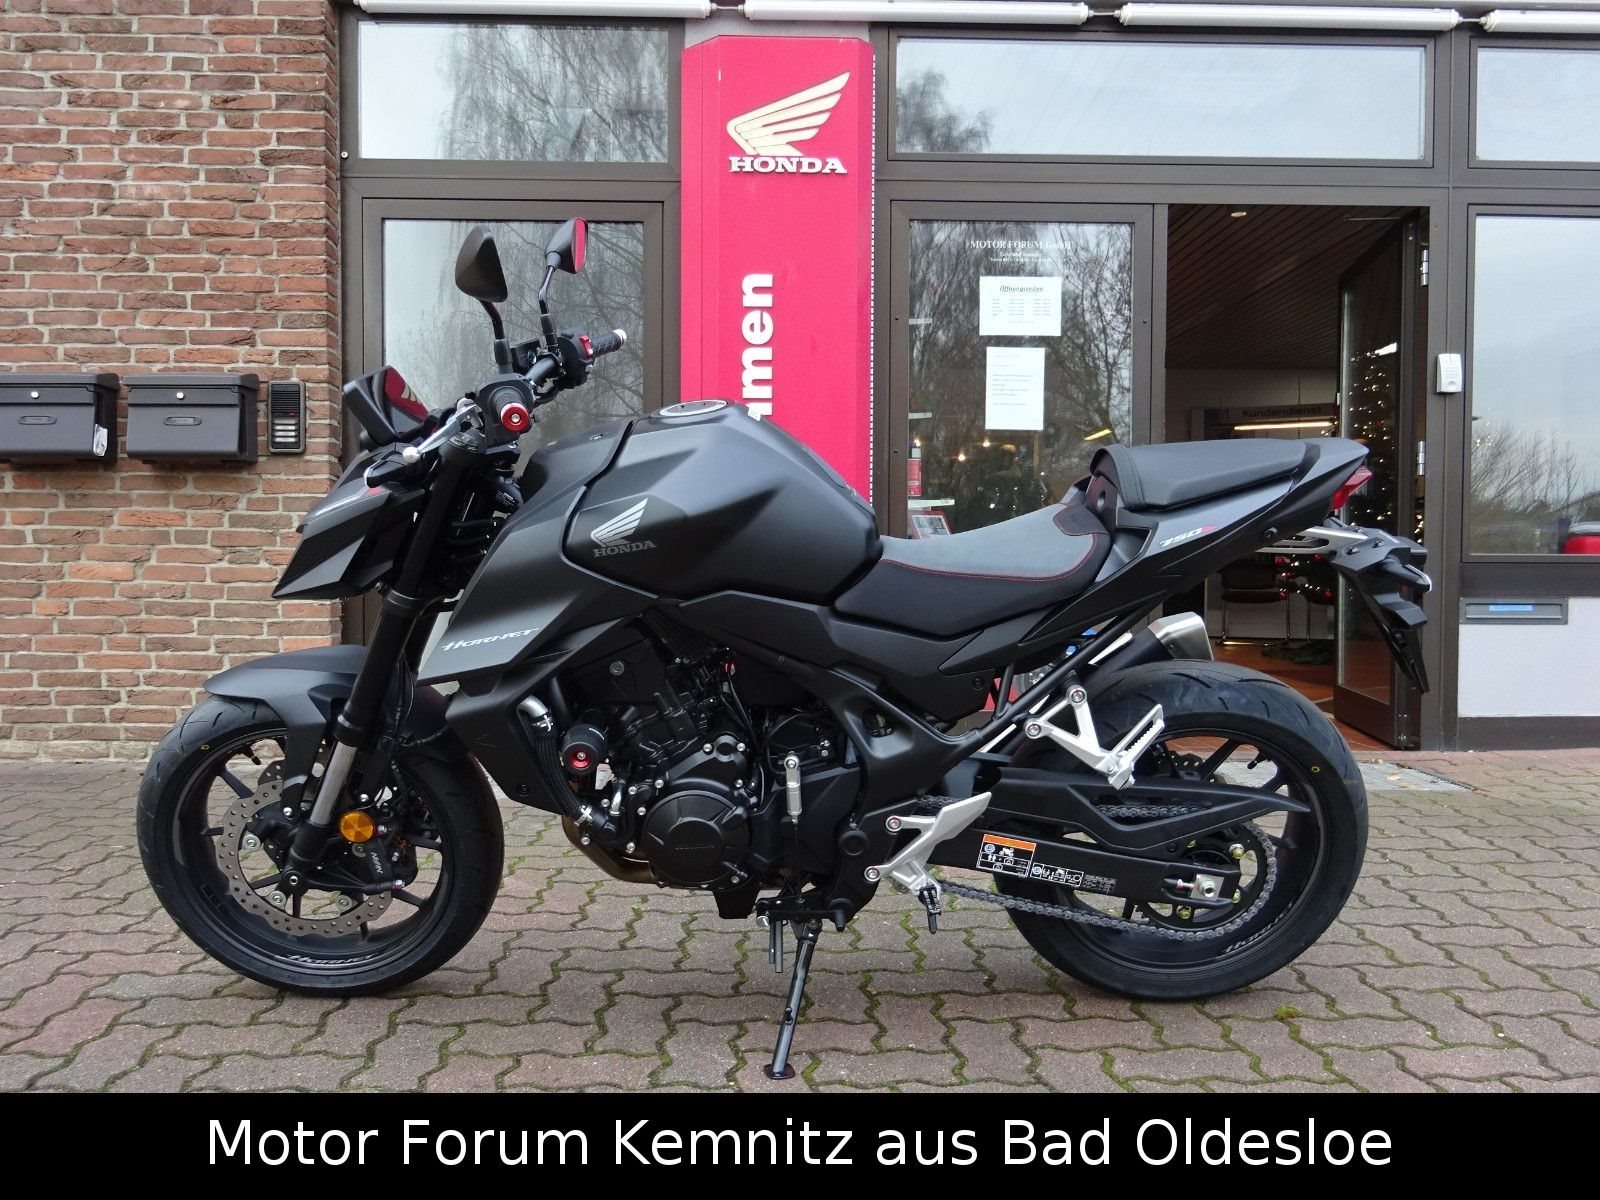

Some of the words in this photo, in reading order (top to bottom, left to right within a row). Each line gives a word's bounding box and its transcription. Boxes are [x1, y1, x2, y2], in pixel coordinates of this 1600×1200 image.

[728, 156, 848, 175] HONDA
[970, 239, 1006, 250] MOTOR
[1008, 240, 1043, 250] FORUM
[593, 540, 656, 558] HONDA
